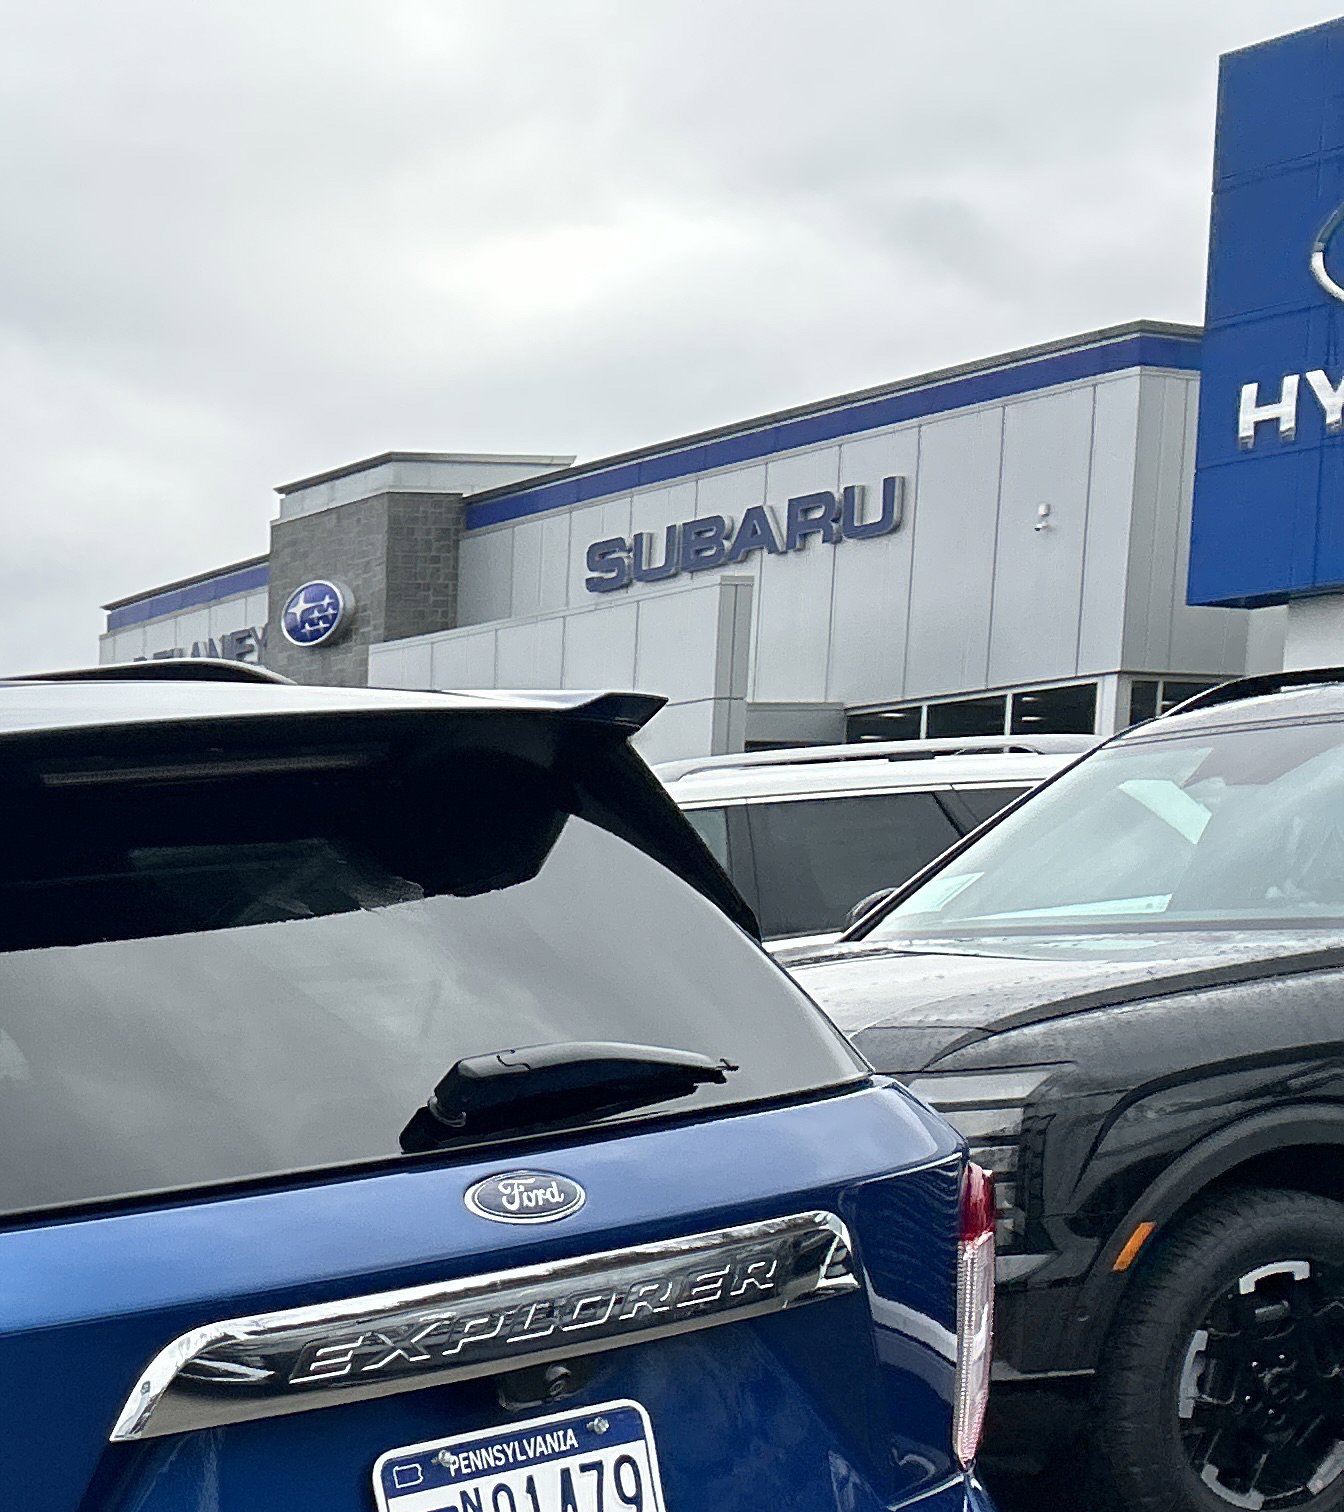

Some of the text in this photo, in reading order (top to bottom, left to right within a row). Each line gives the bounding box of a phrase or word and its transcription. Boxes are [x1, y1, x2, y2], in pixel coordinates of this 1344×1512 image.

[1238, 369, 1344, 446] HY
[585, 476, 905, 592] SUBARU
[498, 1178, 564, 1210] Ford
[289, 1258, 778, 1384] EXPLORER
[449, 1428, 579, 1477] PENNSYLVANIA
